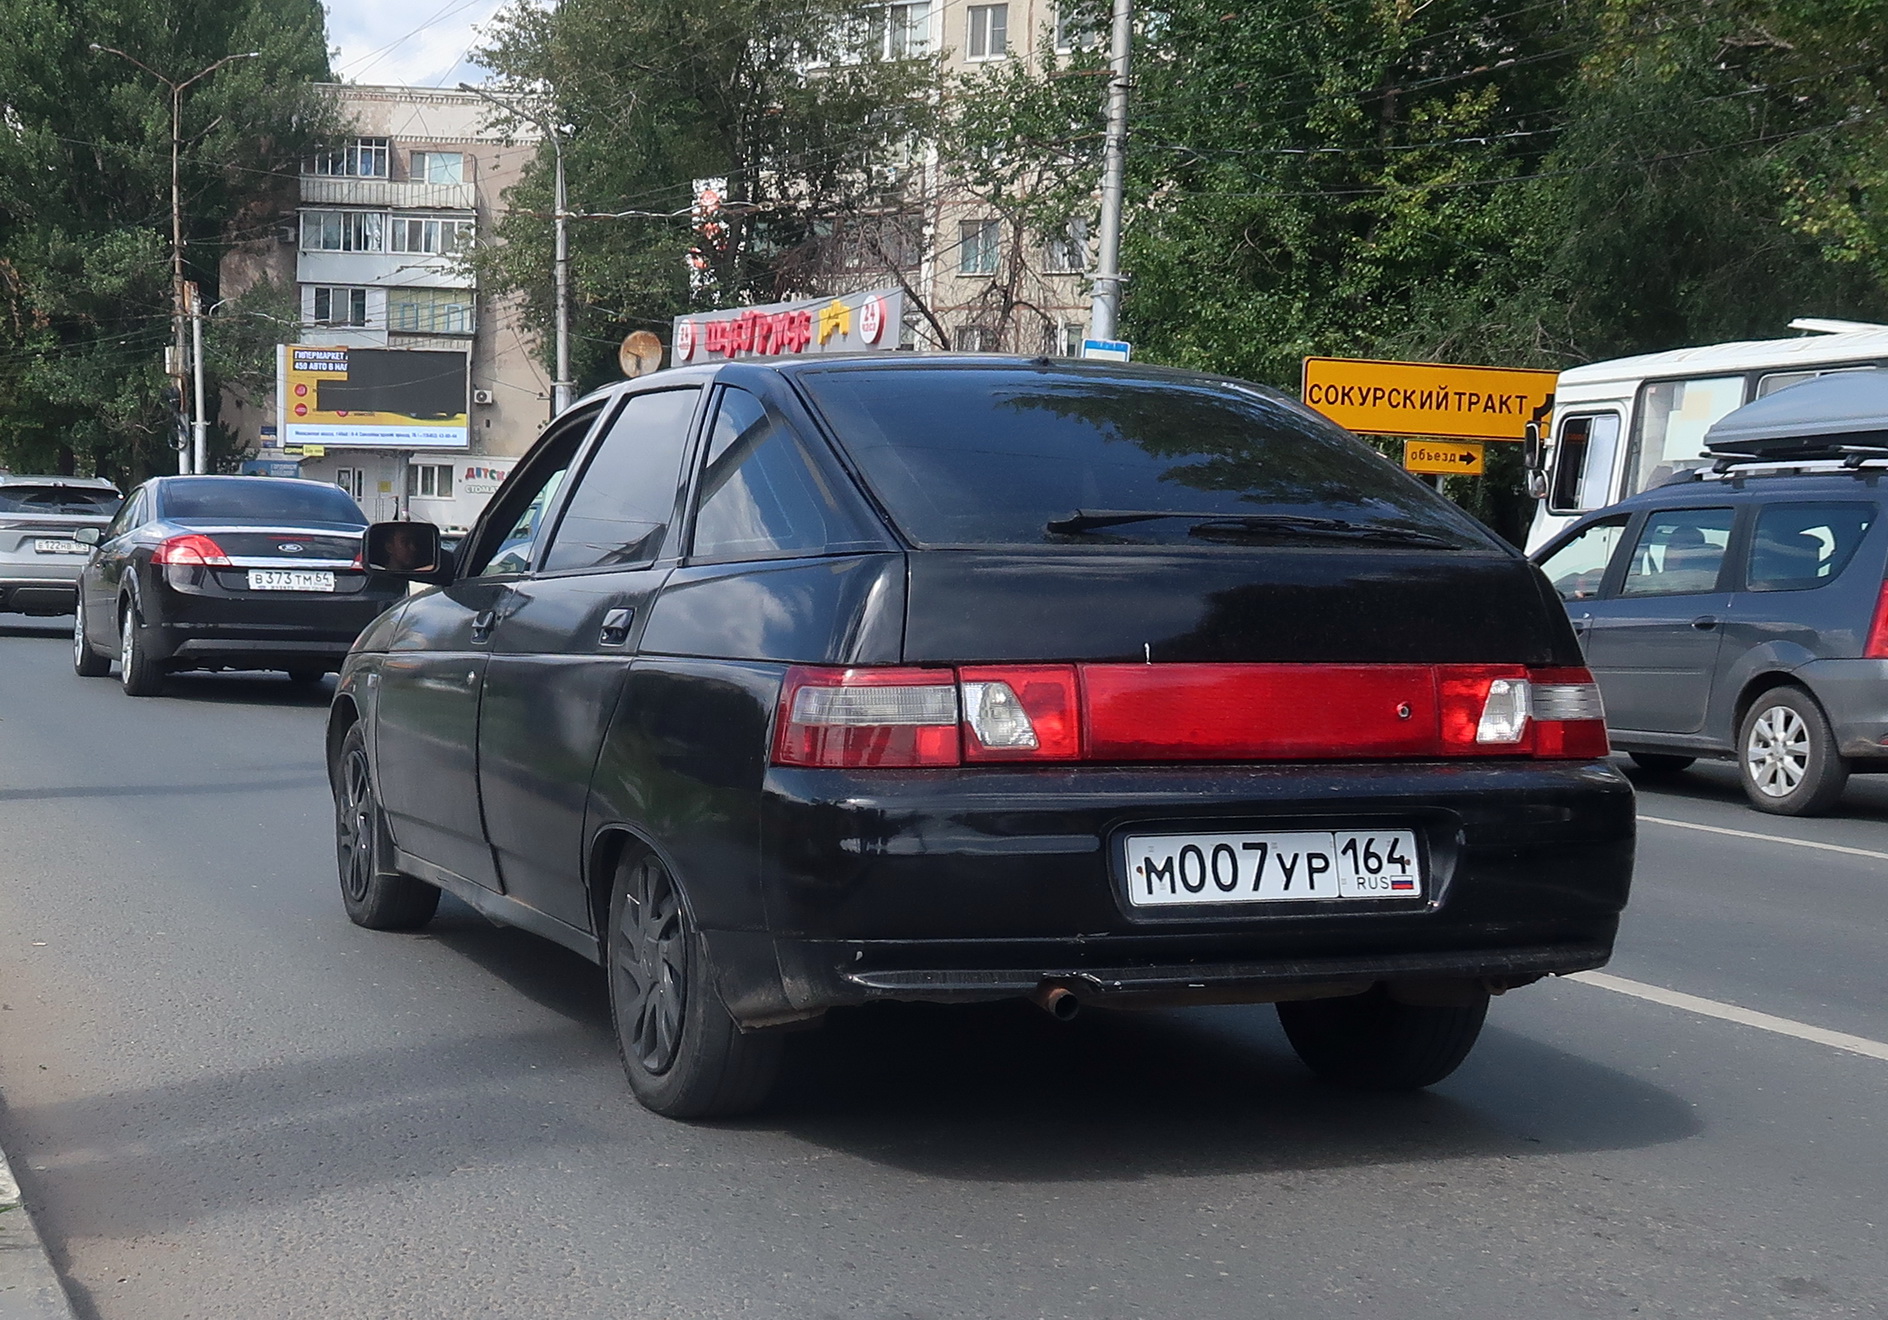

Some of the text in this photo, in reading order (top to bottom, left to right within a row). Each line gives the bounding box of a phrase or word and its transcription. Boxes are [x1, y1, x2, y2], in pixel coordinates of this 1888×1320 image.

[864, 304, 876, 321] 24
[294, 351, 345, 360] ГИПЕРМАРКЕТ
[309, 362, 328, 370] АВТО
[1308, 384, 1528, 415] СОКУРСКИЙ ТРАКТ
[1411, 448, 1457, 463] объезд
[465, 467, 511, 481] ДЕТСК
[1143, 837, 1406, 895] М007УР 164
[1357, 876, 1389, 890] RUS
